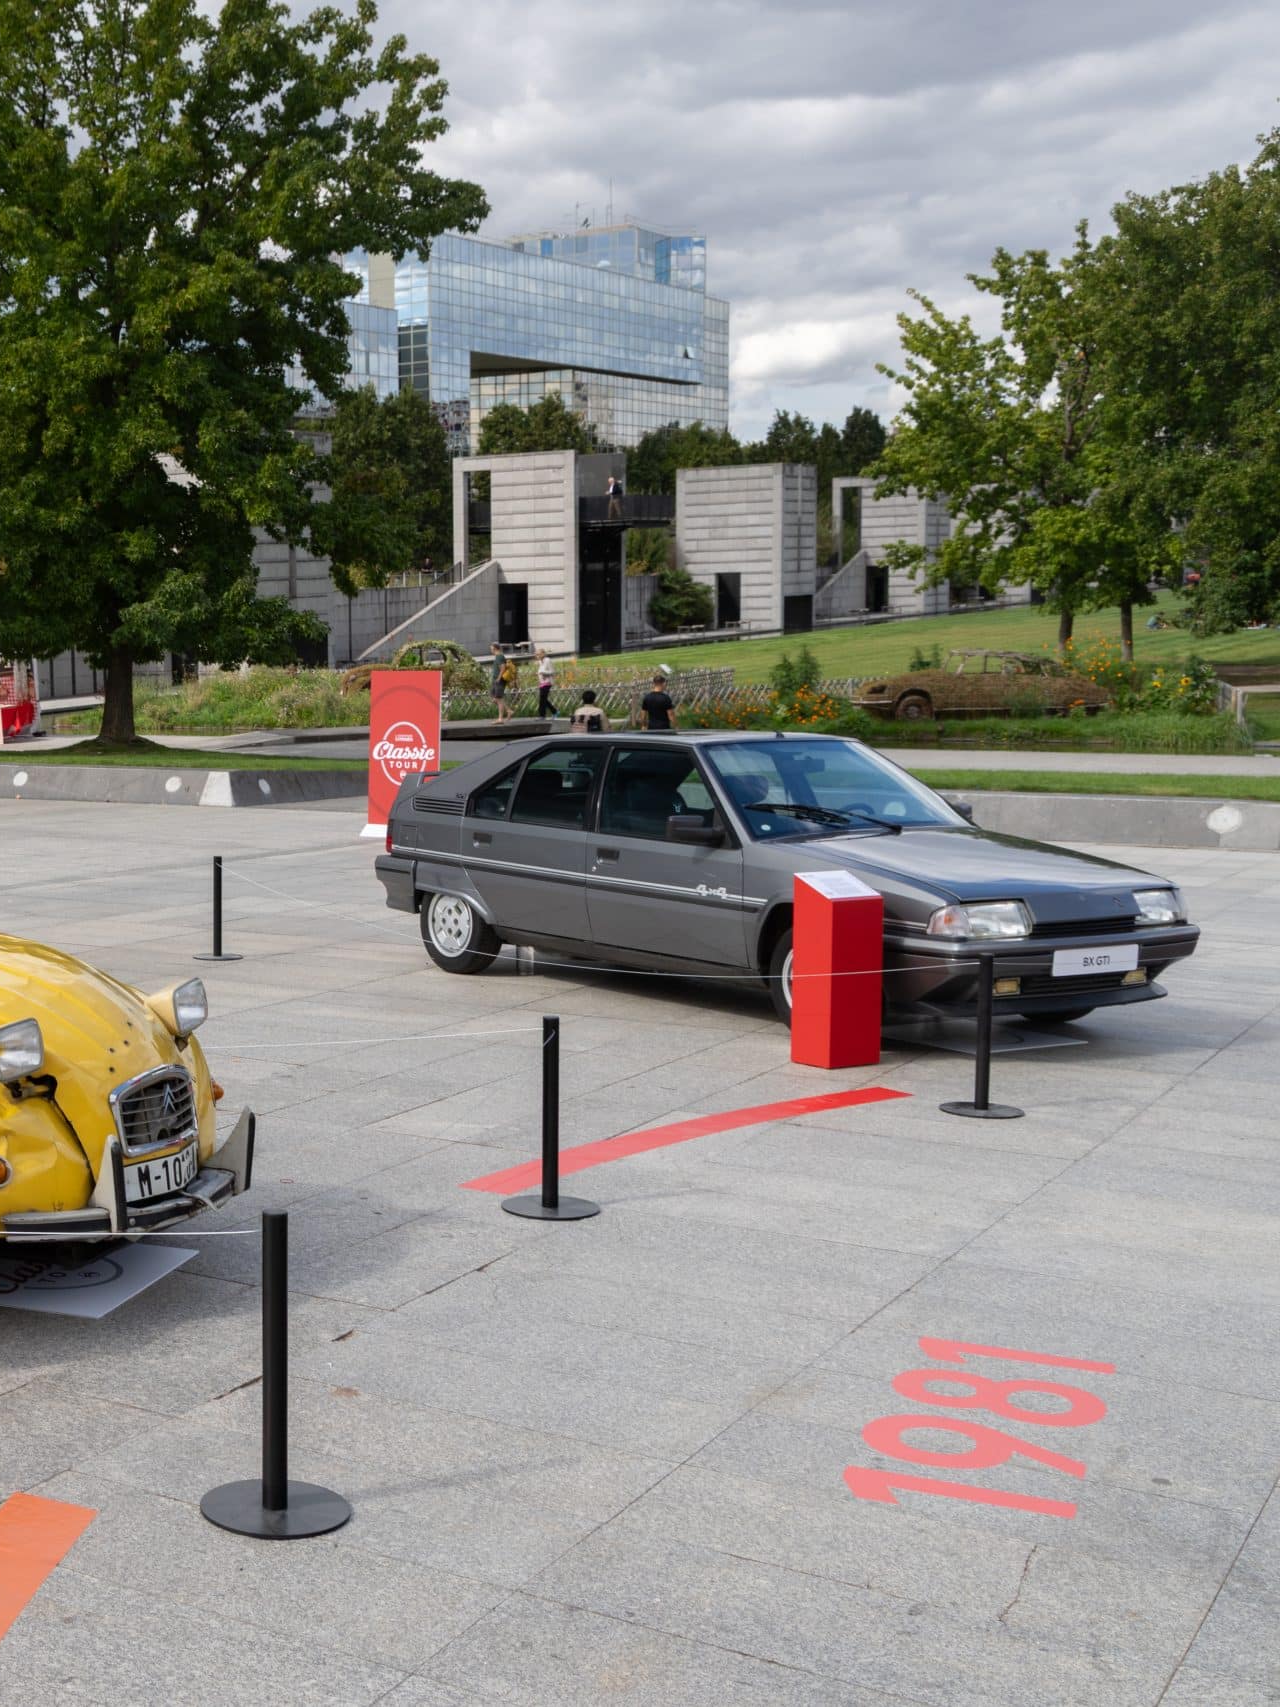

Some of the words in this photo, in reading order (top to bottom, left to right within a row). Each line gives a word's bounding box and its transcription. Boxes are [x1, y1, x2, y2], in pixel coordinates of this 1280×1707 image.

[373, 741, 435, 761] Classic
[389, 761, 418, 769] TOUR
[1096, 955, 1111, 966] GTI
[843, 1336, 1117, 1520] 1981
